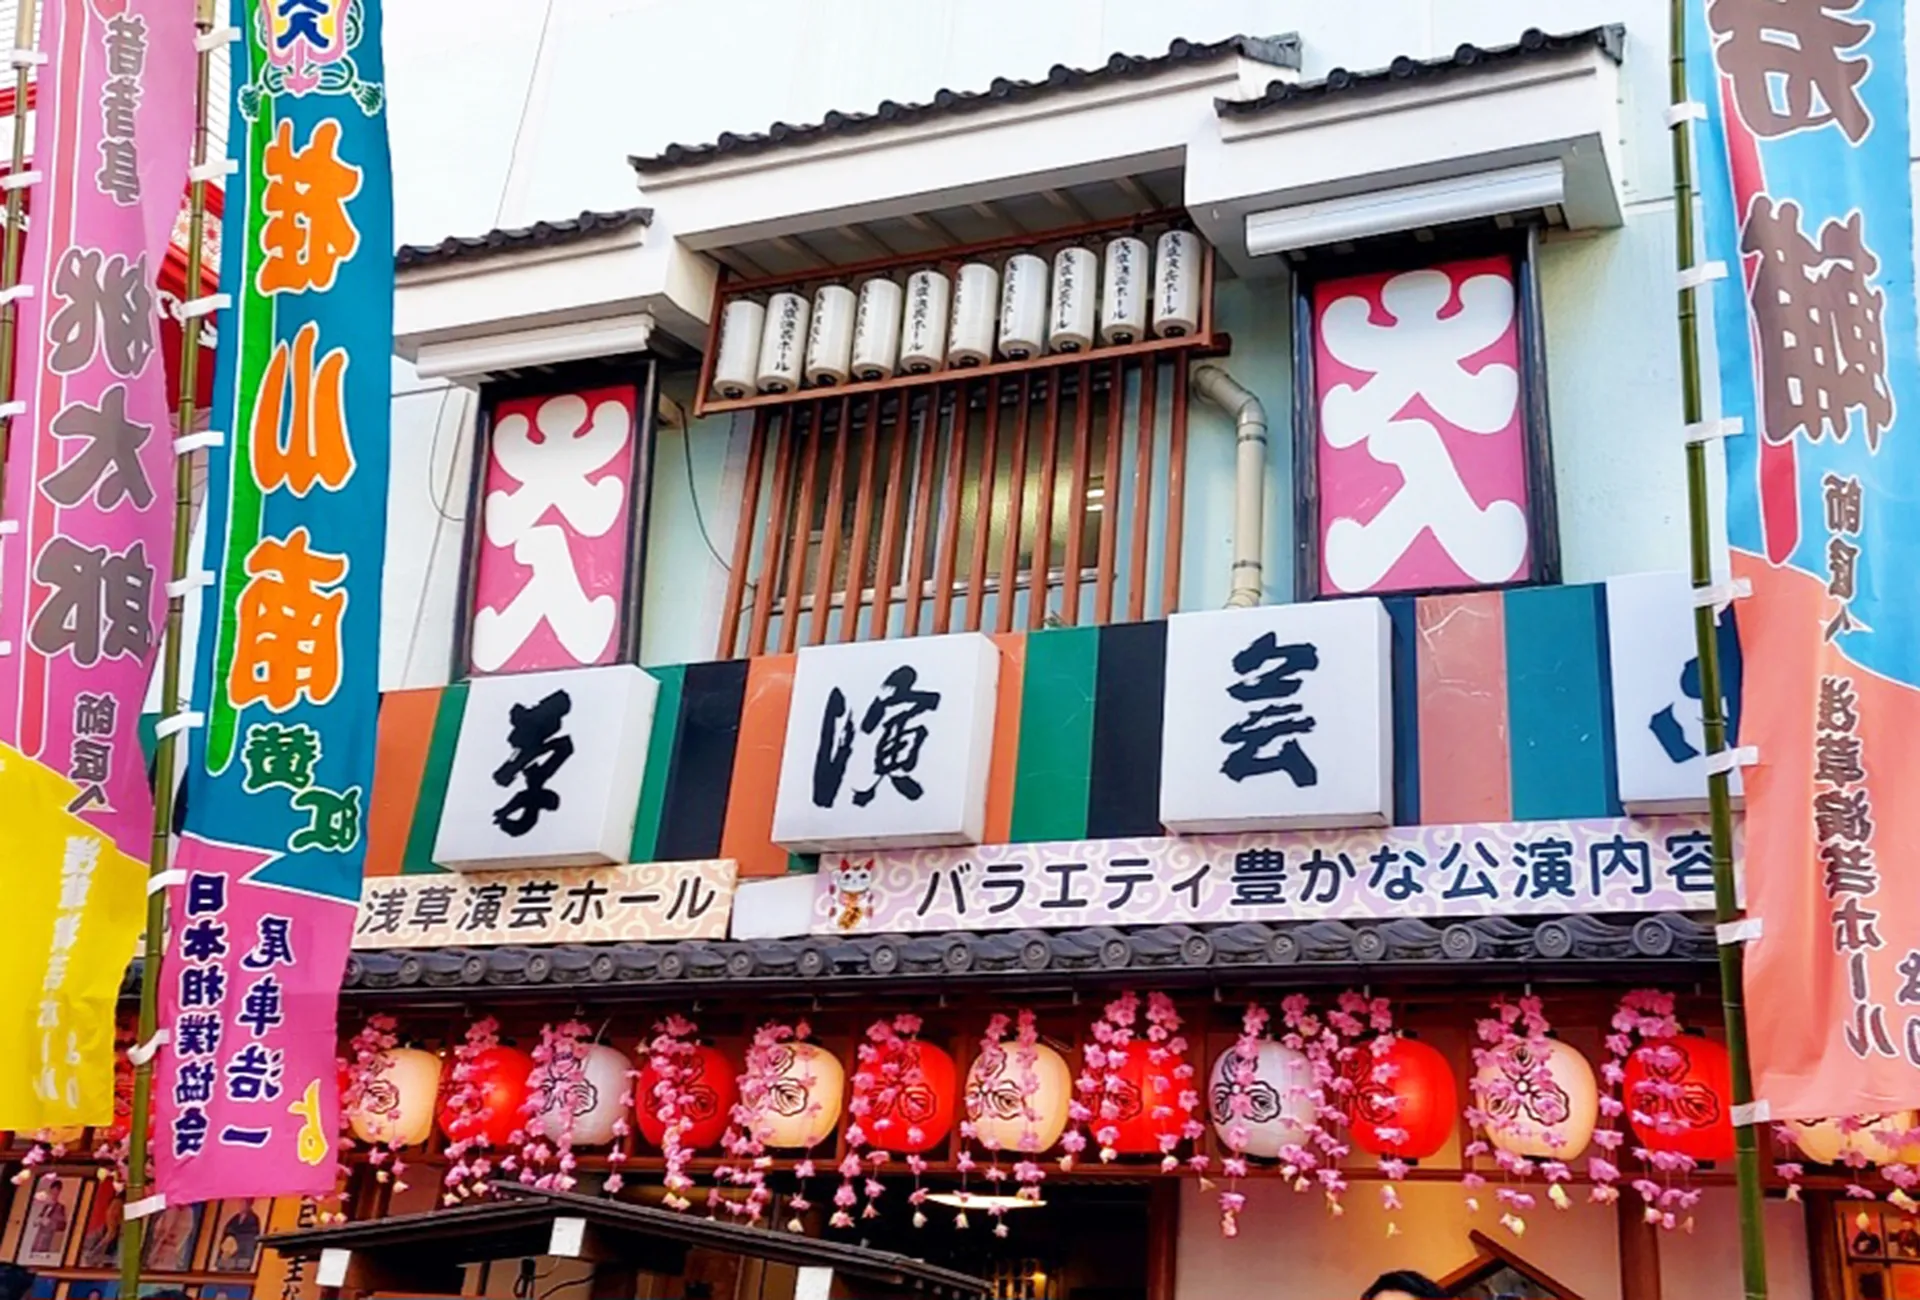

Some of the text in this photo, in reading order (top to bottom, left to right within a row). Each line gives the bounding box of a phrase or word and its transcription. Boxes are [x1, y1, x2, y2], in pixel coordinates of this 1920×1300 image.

[358, 877, 715, 935] 浅草演芸ホール
[917, 830, 1717, 917] バラエティ豊かな公演内容
